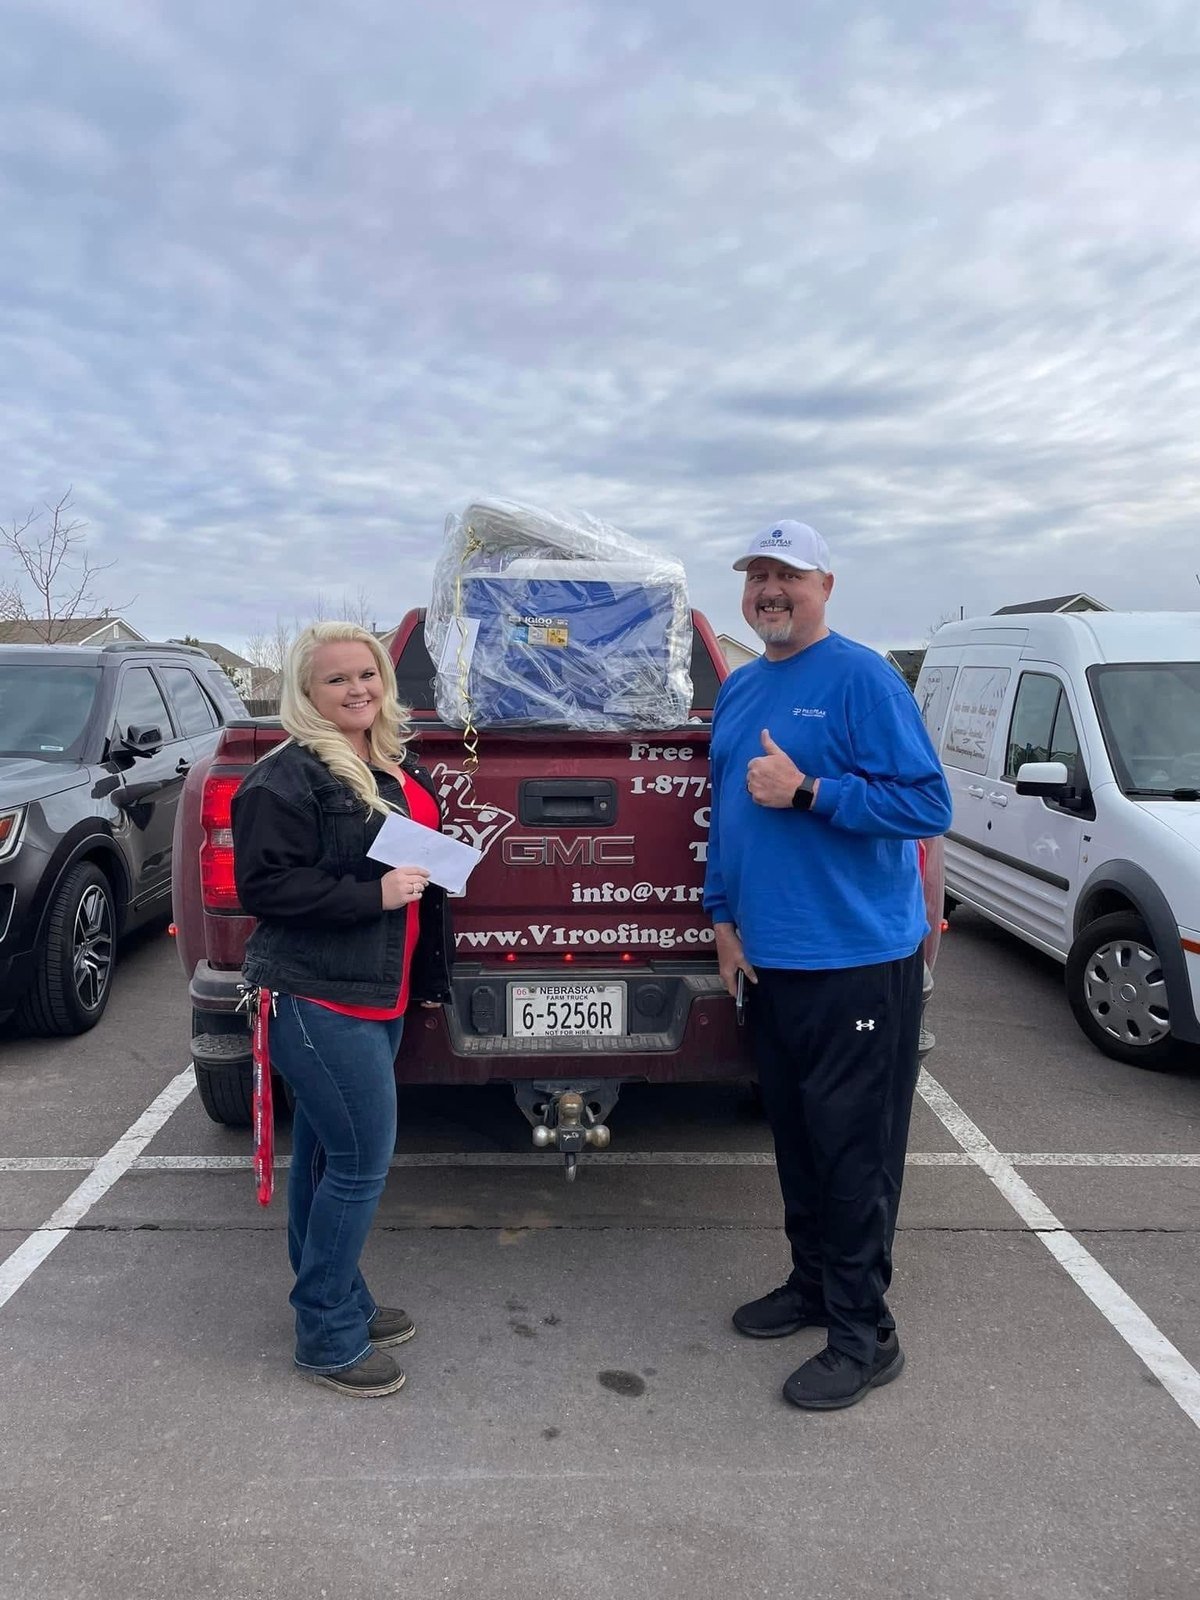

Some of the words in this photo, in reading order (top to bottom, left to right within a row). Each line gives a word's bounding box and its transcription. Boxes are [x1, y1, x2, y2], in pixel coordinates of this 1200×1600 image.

[629, 743, 694, 761] Free
[502, 836, 635, 865] GMC
[540, 986, 595, 995] NEBRASKA
[522, 1002, 612, 1030] 6-5256R
